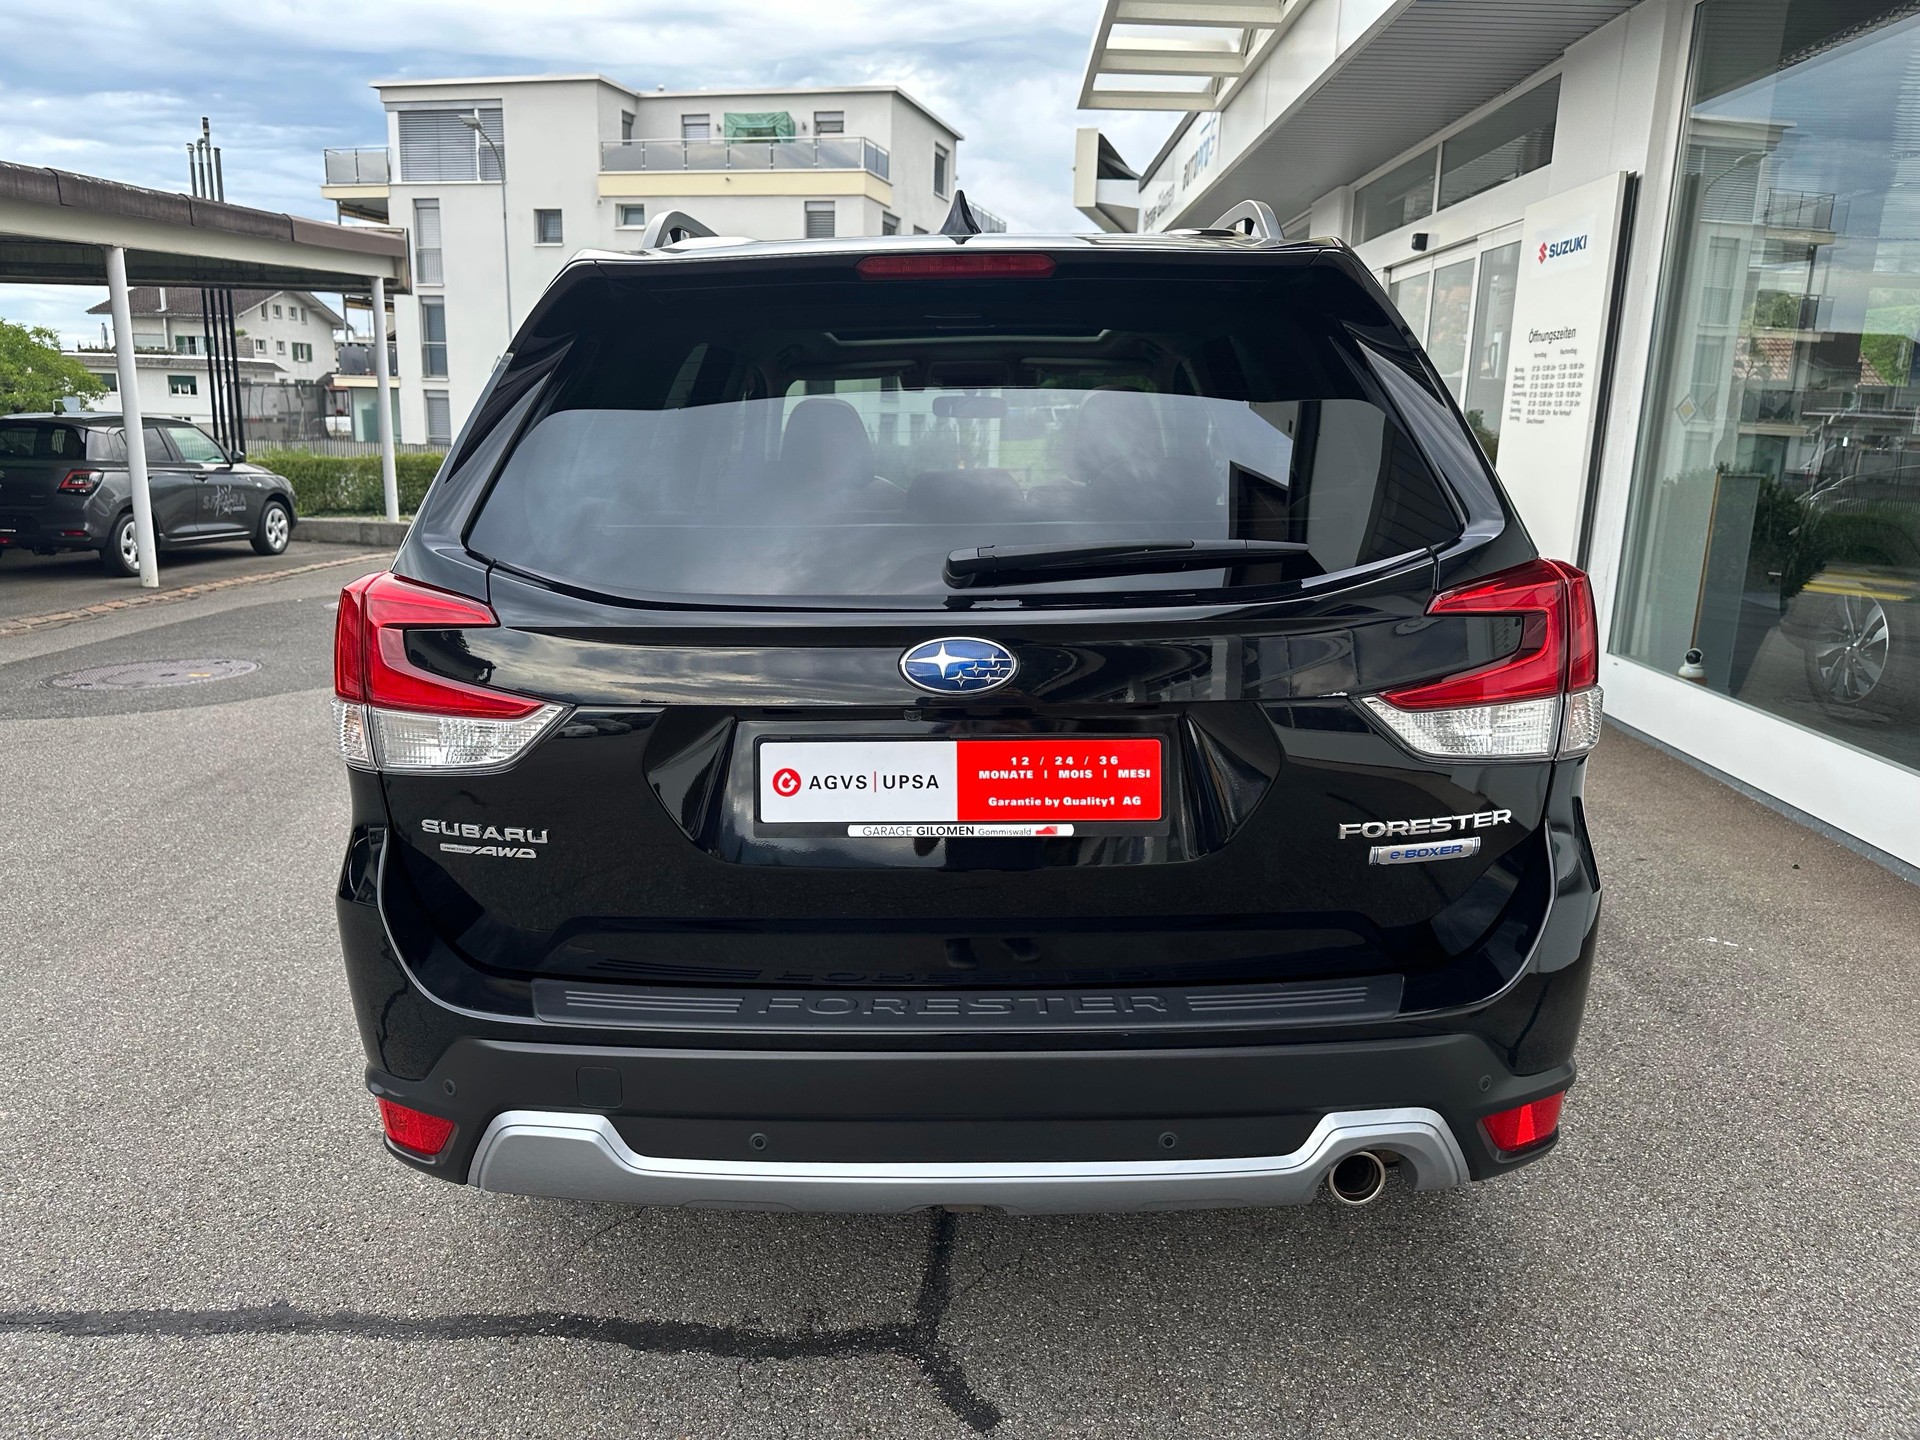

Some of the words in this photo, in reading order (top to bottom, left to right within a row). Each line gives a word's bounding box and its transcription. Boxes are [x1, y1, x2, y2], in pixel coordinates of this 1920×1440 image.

[1549, 235, 1587, 258] SUZUKI
[1529, 327, 1576, 344] Öffnungszeiten
[1011, 756, 1030, 766] 12
[1055, 756, 1074, 766] 24
[1099, 755, 1119, 765] 36
[809, 775, 867, 790] AGVS
[883, 774, 940, 789] UPSA
[978, 770, 1034, 779] MONATE
[1058, 769, 1093, 779] MOIS
[1117, 769, 1151, 778] MESI
[988, 797, 1042, 806] Garantie
[1045, 796, 1060, 808] by
[1063, 796, 1115, 808] Quality1
[1122, 796, 1141, 805] AG
[421, 818, 550, 844] SUBARU
[862, 826, 913, 836] GARAGE
[916, 825, 974, 836] GILOMEN
[978, 827, 1032, 836] Gommiswald
[1337, 808, 1512, 840] FORESTER
[474, 846, 537, 859] AWD
[1389, 844, 1463, 860] e-BOXER
[758, 996, 1167, 1016] FORESTER
